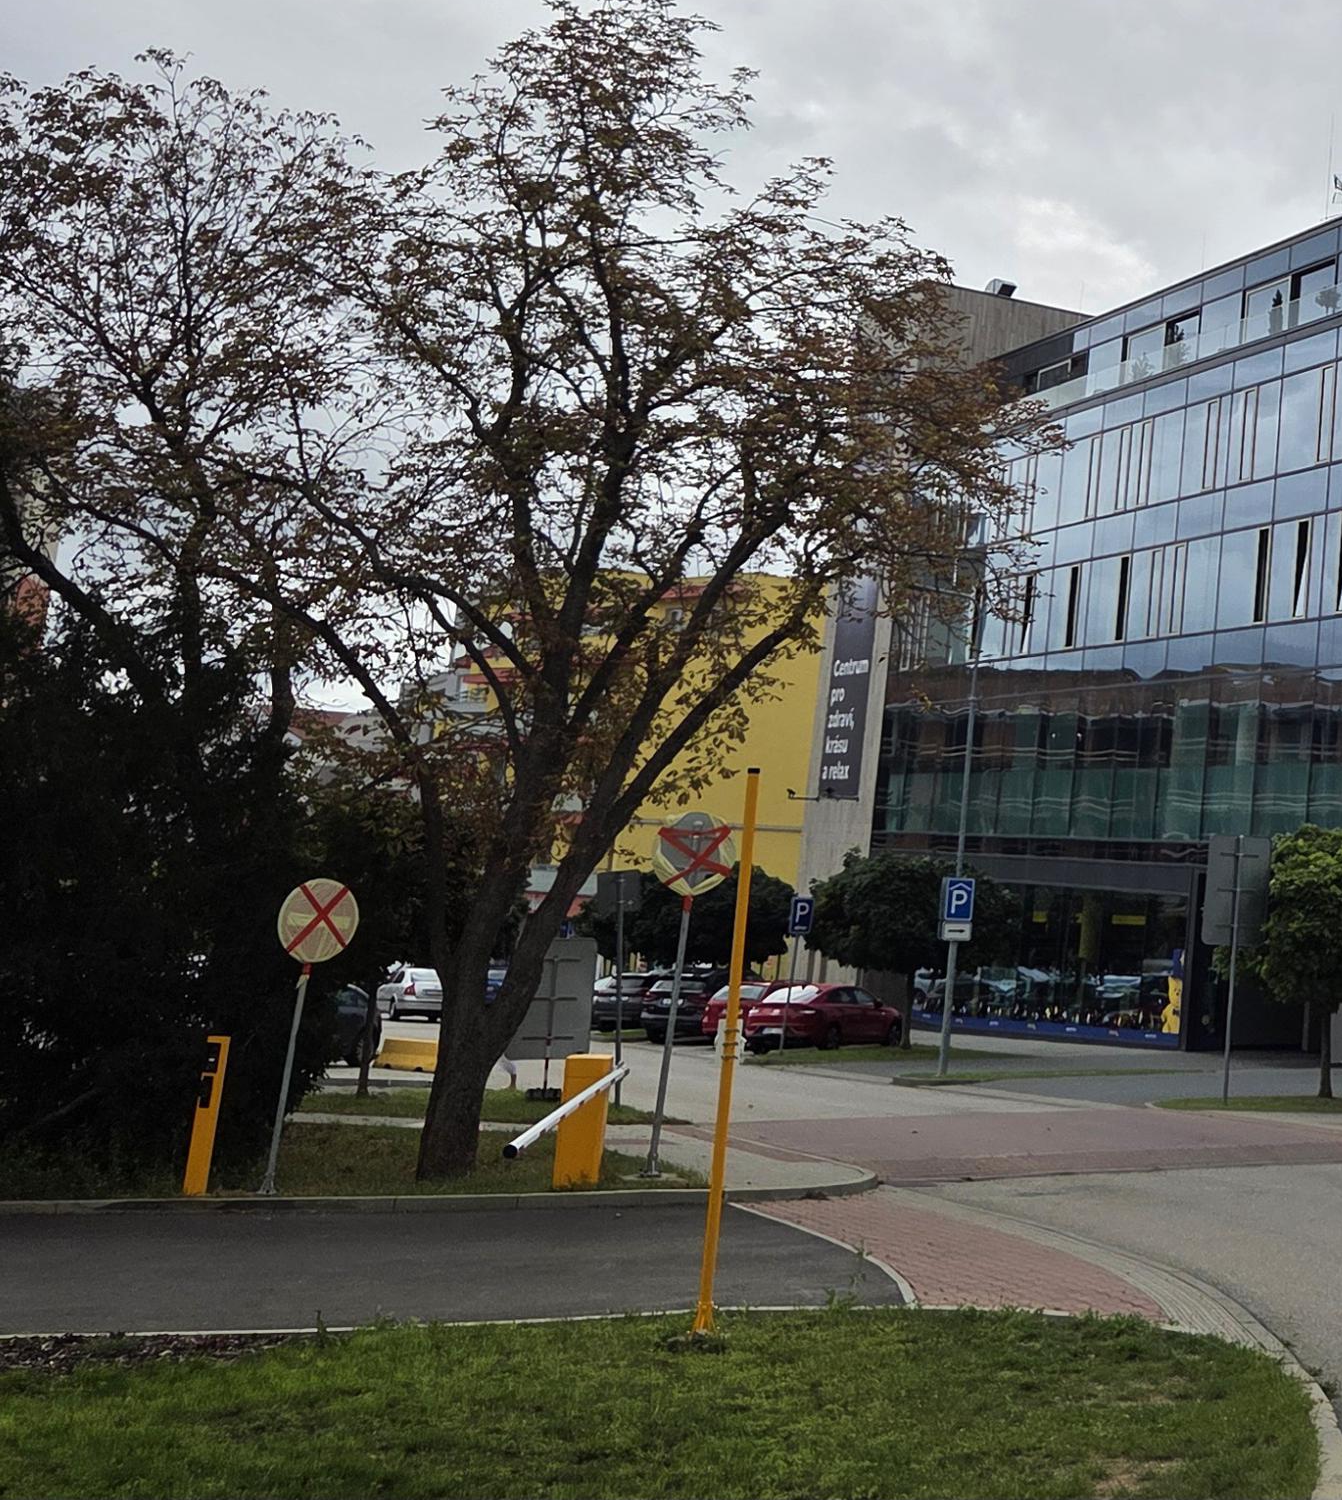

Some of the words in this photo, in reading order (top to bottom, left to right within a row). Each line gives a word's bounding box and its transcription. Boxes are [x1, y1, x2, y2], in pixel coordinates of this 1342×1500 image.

[834, 659, 869, 677] Centrum
[830, 687, 845, 707] pro
[825, 735, 849, 754] krásu
[822, 765, 828, 780] a
[829, 760, 850, 780] relax
[951, 889, 968, 914] P
[795, 902, 809, 923] P
